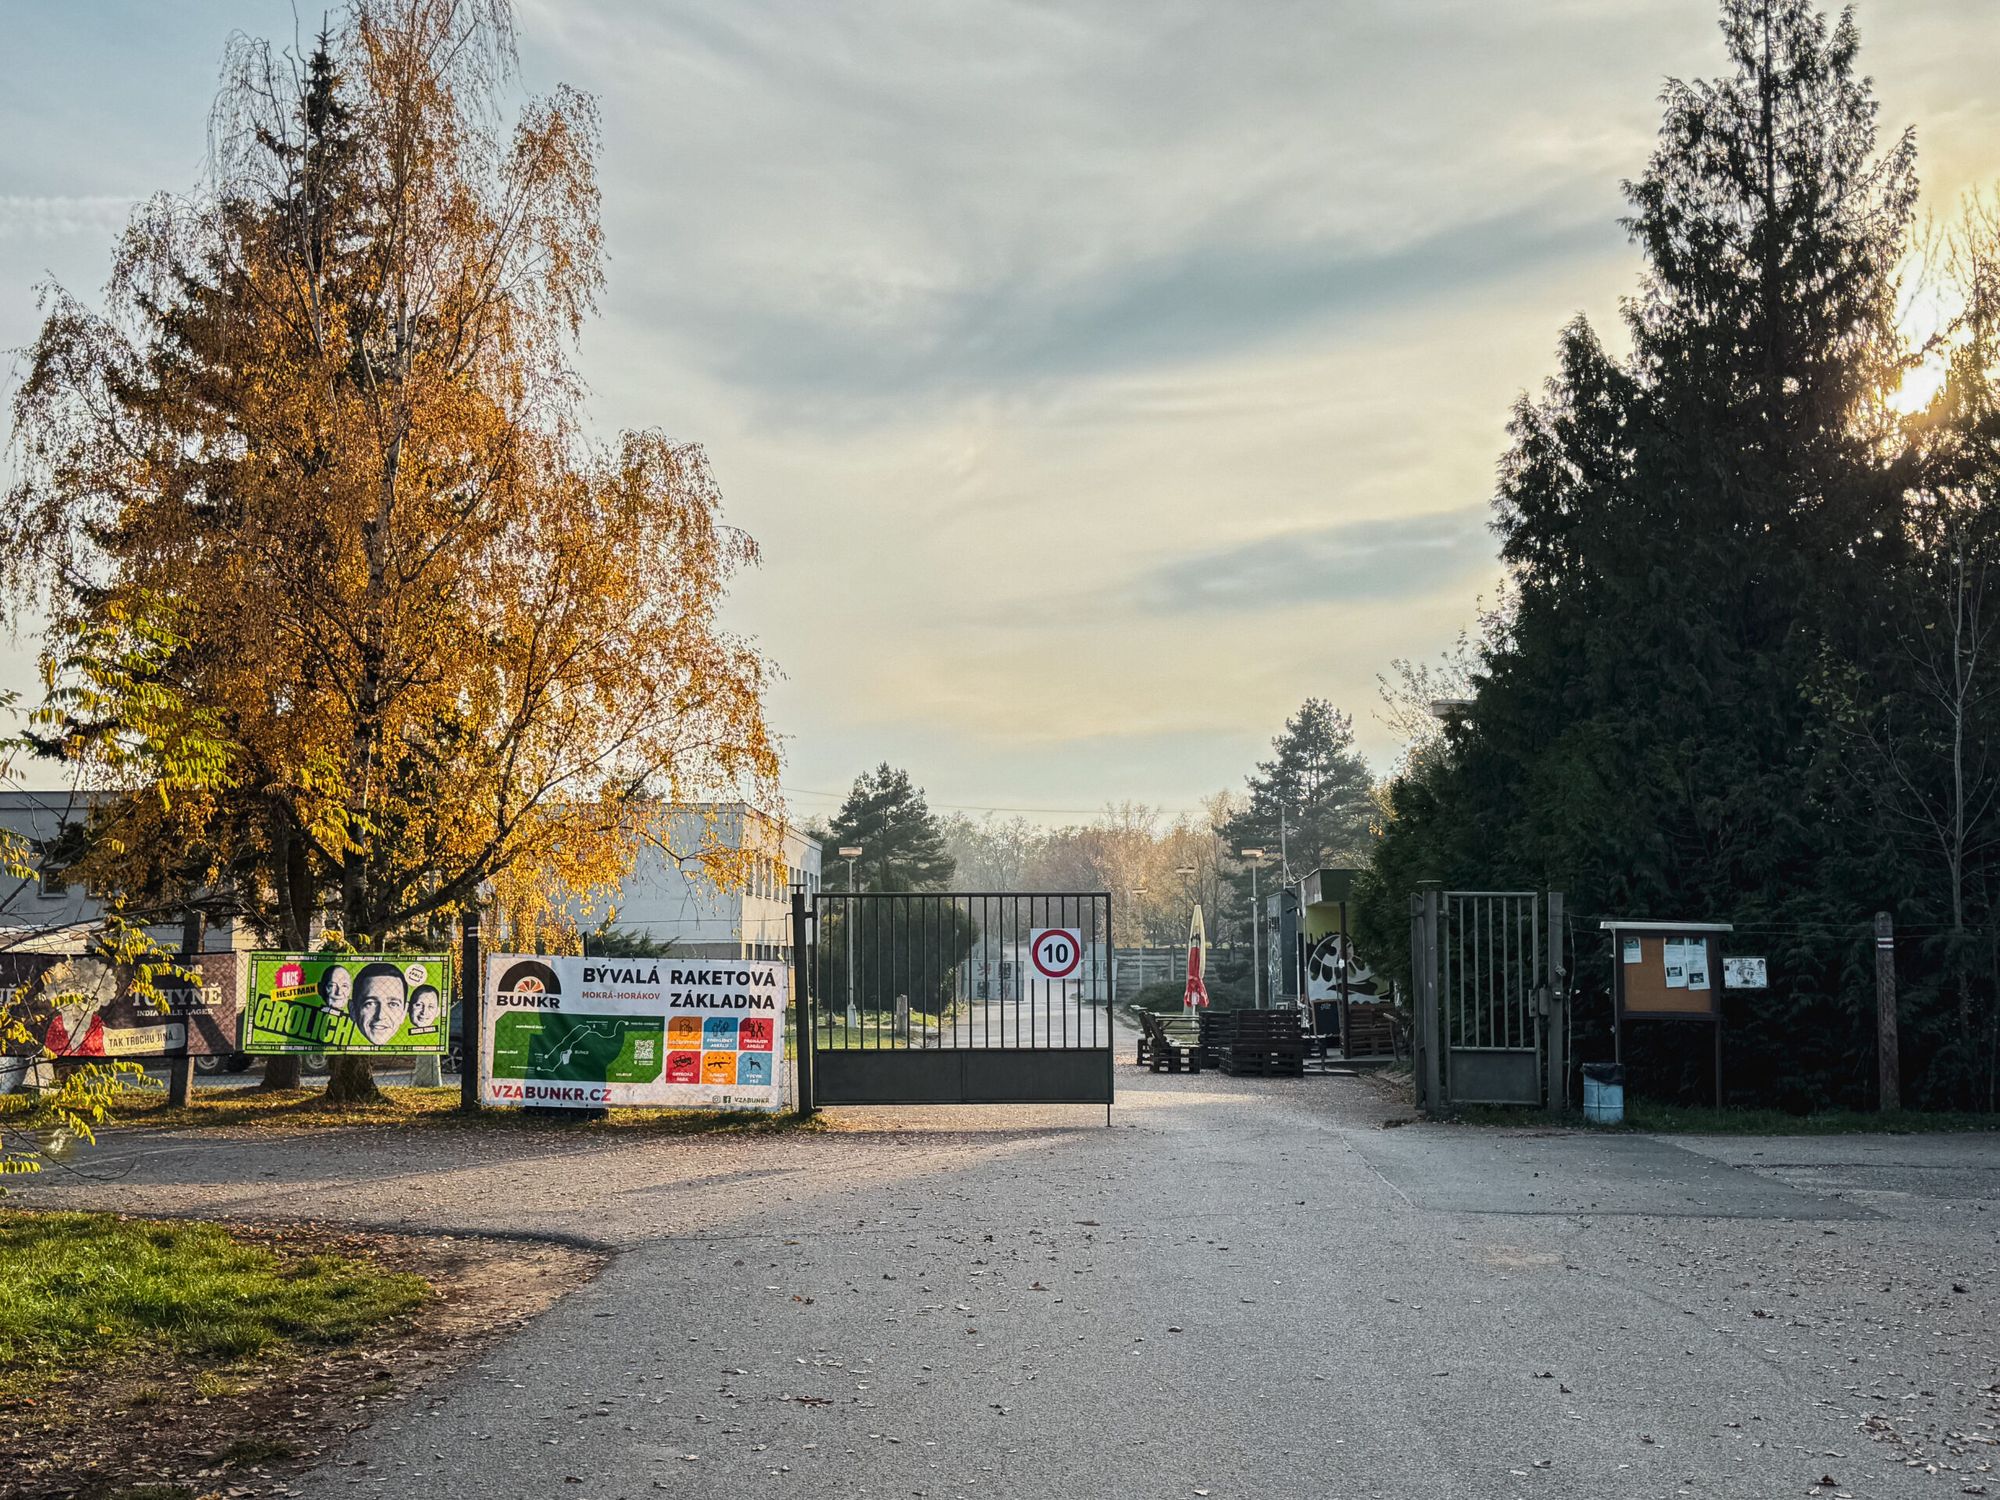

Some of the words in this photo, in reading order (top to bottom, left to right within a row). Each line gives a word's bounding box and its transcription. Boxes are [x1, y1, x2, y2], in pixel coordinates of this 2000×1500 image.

[1043, 943, 1068, 964] 10
[281, 971, 299, 987] AKCE
[583, 964, 660, 984] BÝVALÁ
[670, 968, 776, 987] RAKETOVÁ
[276, 985, 316, 999] HEJTMAN
[581, 990, 660, 1001] MOKRÁ-HORÁKOV
[670, 990, 775, 1009] ZÁKLADNA
[496, 995, 560, 1009] BUNKR
[136, 1009, 159, 1017] INDIA
[185, 1008, 214, 1016] LAGER
[254, 997, 354, 1045] GROLICH
[108, 1037, 123, 1048] TAK
[126, 1035, 155, 1046] TROCHU
[492, 1085, 612, 1102] VZABUNKR.CZ
